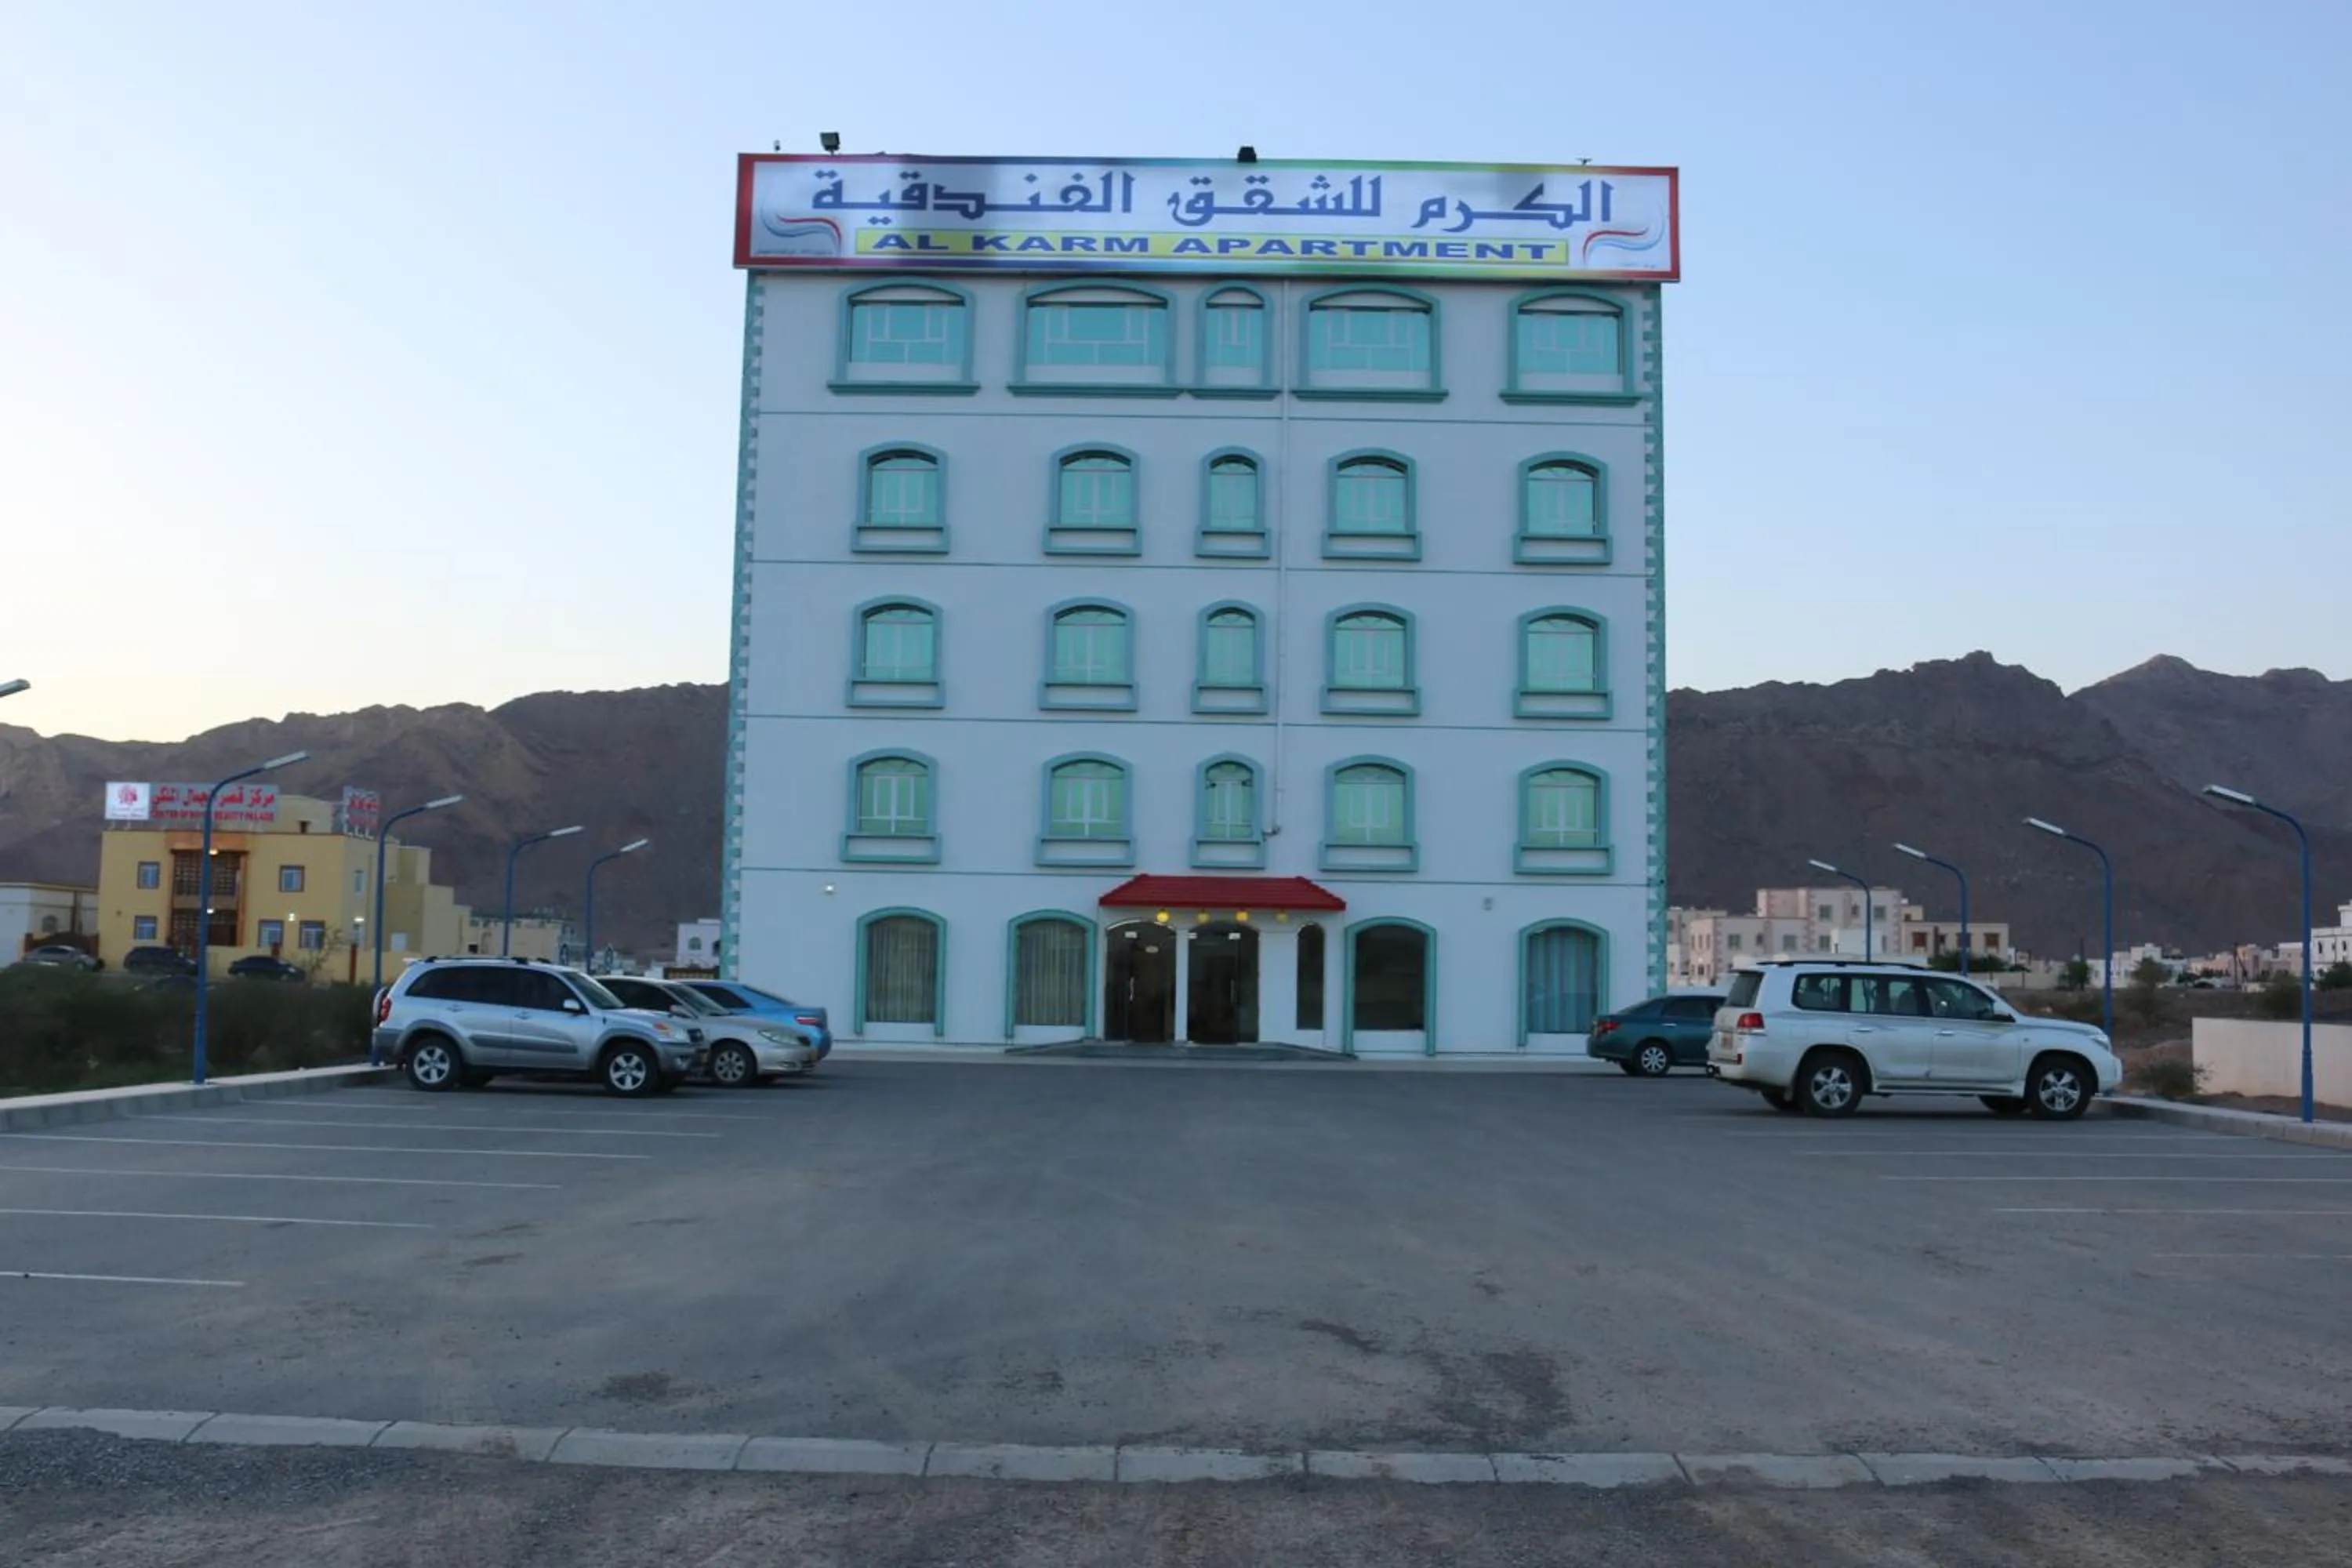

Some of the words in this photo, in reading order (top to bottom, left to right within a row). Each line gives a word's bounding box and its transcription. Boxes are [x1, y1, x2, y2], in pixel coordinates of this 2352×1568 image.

[812, 169, 1135, 224] الفندقية
[1167, 174, 1381, 227] للشقق
[1410, 180, 1614, 232] الكرم
[872, 234, 949, 251] AL
[971, 234, 1149, 253] KARM
[1173, 237, 1555, 260] APARTMENT
